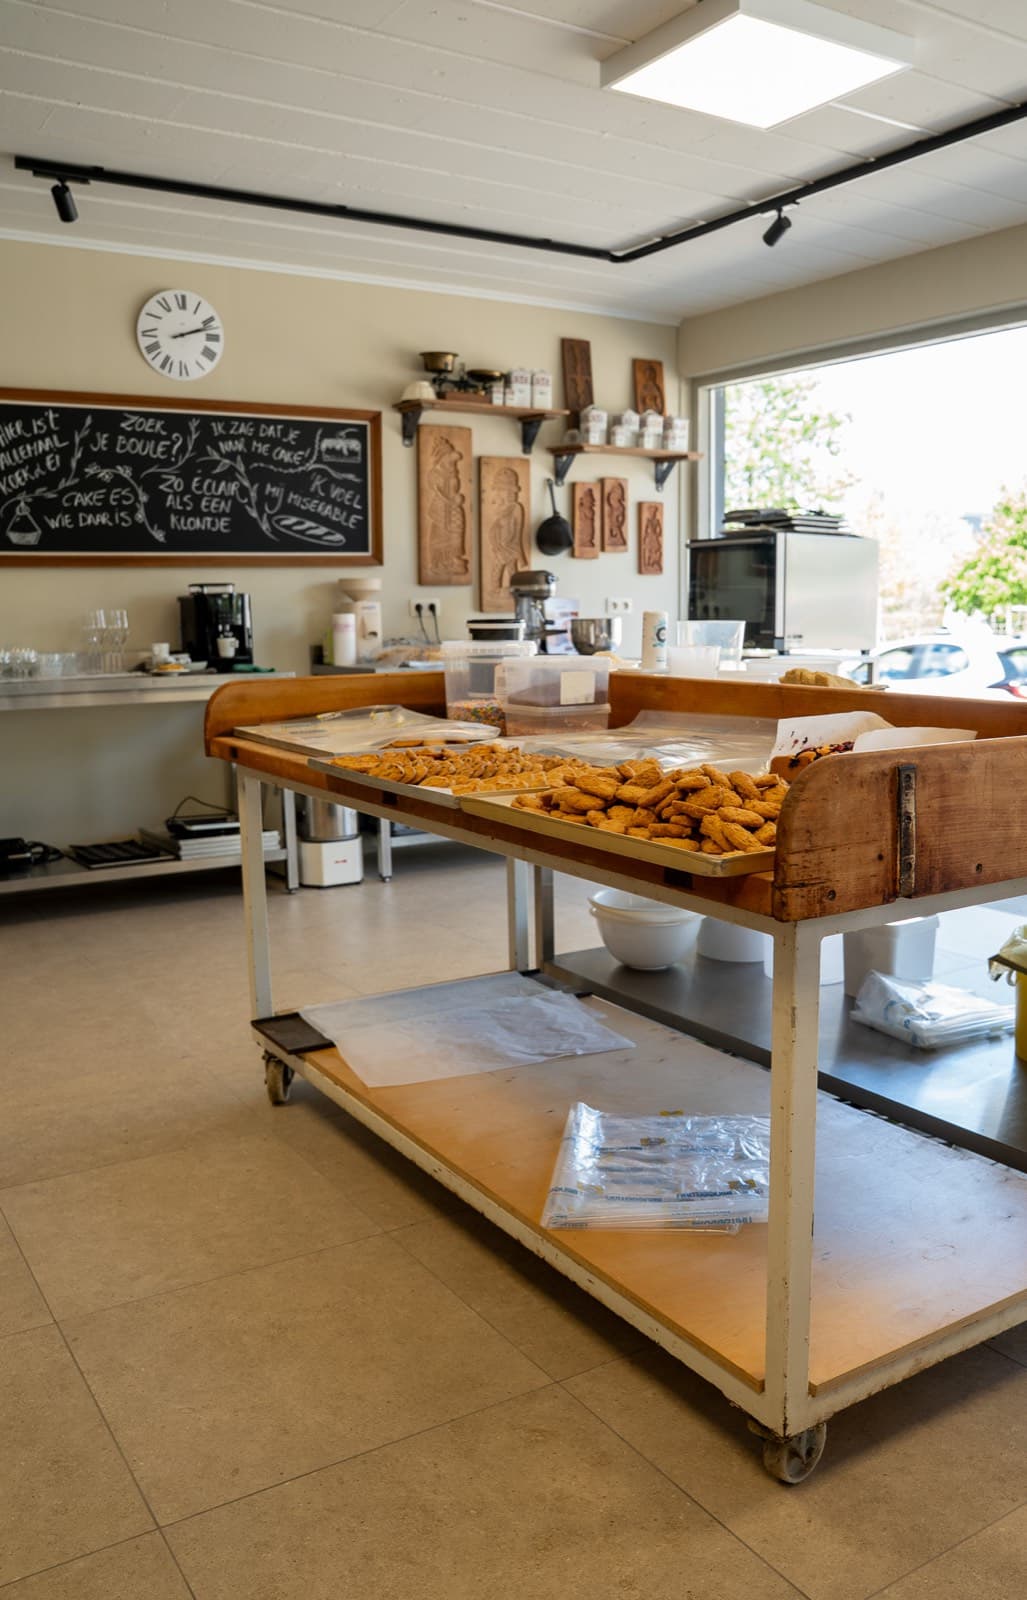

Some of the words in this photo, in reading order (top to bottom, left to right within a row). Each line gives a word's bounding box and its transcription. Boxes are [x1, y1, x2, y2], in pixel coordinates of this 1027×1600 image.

[120, 412, 167, 436] ZOEK
[210, 421, 226, 437] IK
[259, 423, 284, 438] DAT
[282, 427, 301, 445] JE
[90, 431, 109, 452] JE
[116, 432, 183, 462] BOULE?
[251, 440, 271, 456] ME
[159, 474, 184, 493] ZO
[62, 489, 107, 507] CAKE
[109, 487, 135, 505] ES
[166, 494, 194, 511] ALS
[200, 496, 232, 513] EEN
[330, 483, 363, 510] VOEL
[44, 512, 74, 529] WIE
[288, 491, 363, 529] MISERABLE
[170, 512, 231, 533] KLONTJE
